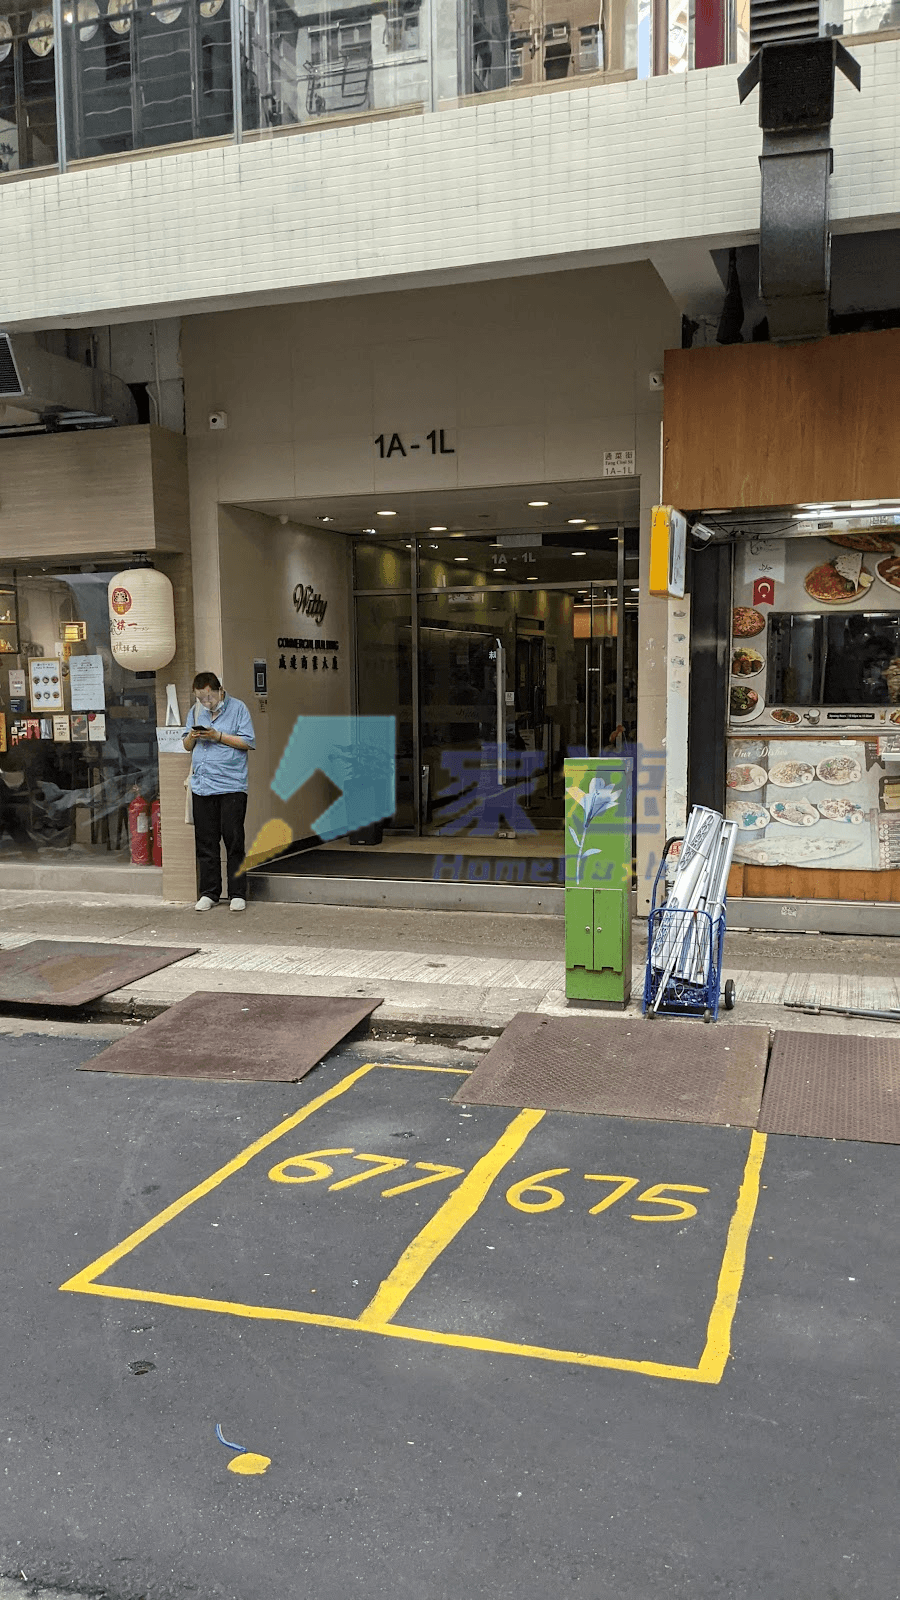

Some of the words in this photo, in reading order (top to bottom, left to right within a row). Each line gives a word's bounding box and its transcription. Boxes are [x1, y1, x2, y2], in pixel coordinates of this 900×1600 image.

[293, 584, 328, 623] Witty
[277, 638, 314, 649] COMMERCIAL
[315, 640, 339, 650] BUILDING
[268, 1147, 465, 1198] 677
[505, 1168, 710, 1222] 675
